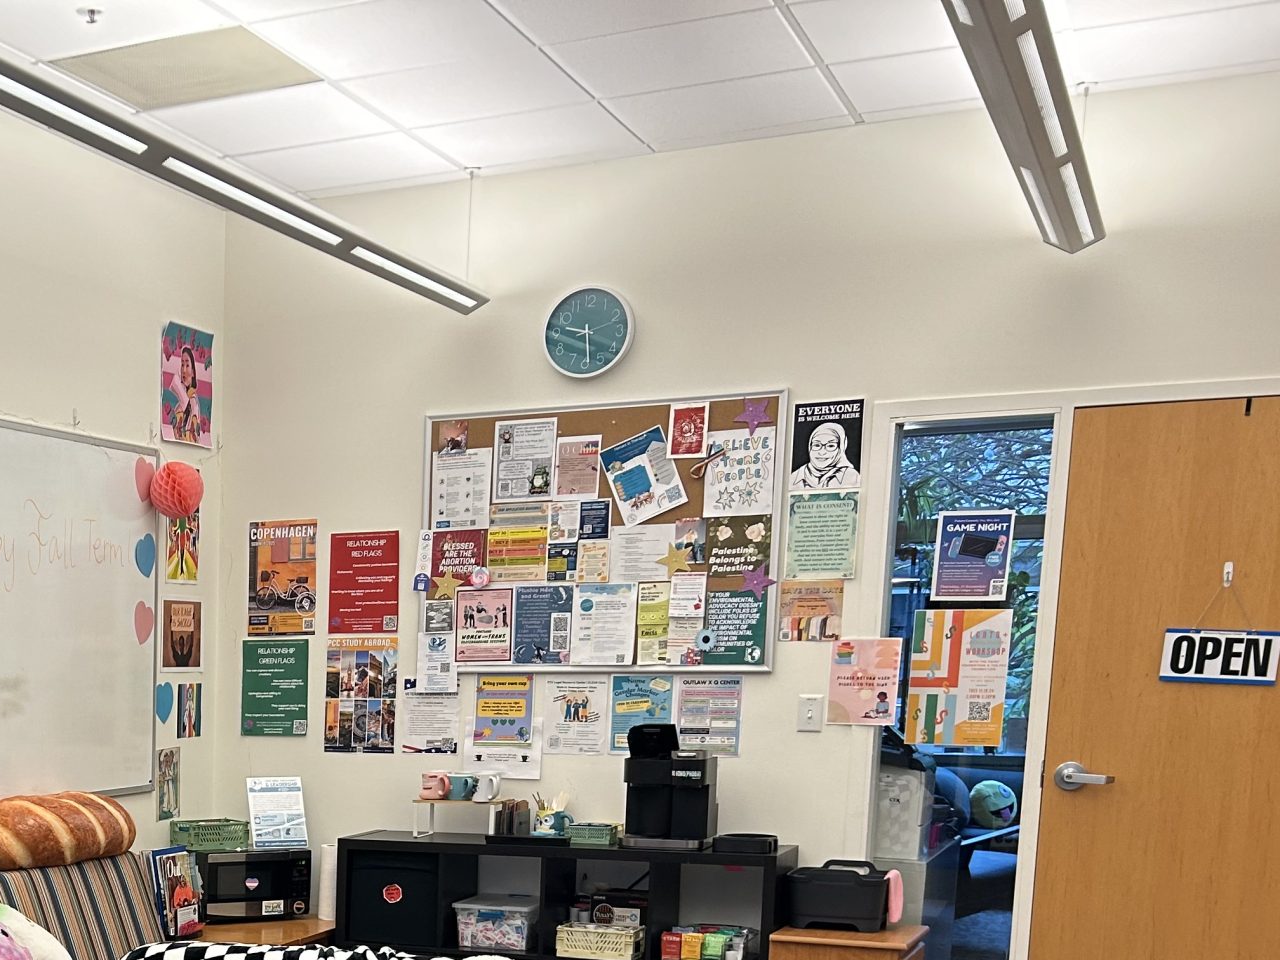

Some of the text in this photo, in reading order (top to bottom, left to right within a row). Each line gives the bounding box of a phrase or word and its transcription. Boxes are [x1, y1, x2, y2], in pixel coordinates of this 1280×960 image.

[572, 300, 580, 313] 11
[585, 295, 597, 307] 12
[560, 312, 572, 325] 10
[611, 308, 620, 322] 2
[552, 327, 561, 339] 9
[615, 324, 624, 337] 3
[555, 343, 564, 356] 8
[608, 341, 616, 352] 4
[569, 353, 577, 369] 7
[580, 357, 590, 370] 6
[596, 352, 605, 365] 5
[798, 404, 860, 416] EVERYONE
[251, 525, 314, 540] COPENHAGEN
[946, 523, 1009, 532] GAME NIGHT
[23, 499, 76, 575] Fall
[347, 539, 387, 547] RELATIONSHIP
[443, 542, 474, 551] BLESSED
[712, 547, 754, 555] Palestine
[441, 557, 476, 566] ABORTION
[709, 556, 745, 564] Belongs
[712, 564, 754, 572] Palestine
[327, 639, 391, 647] PCC STUDY ABROAD
[258, 647, 296, 655] RELATIONSHIP
[965, 647, 1006, 655] WORKSHOP
[1170, 635, 1273, 677] OPEN
